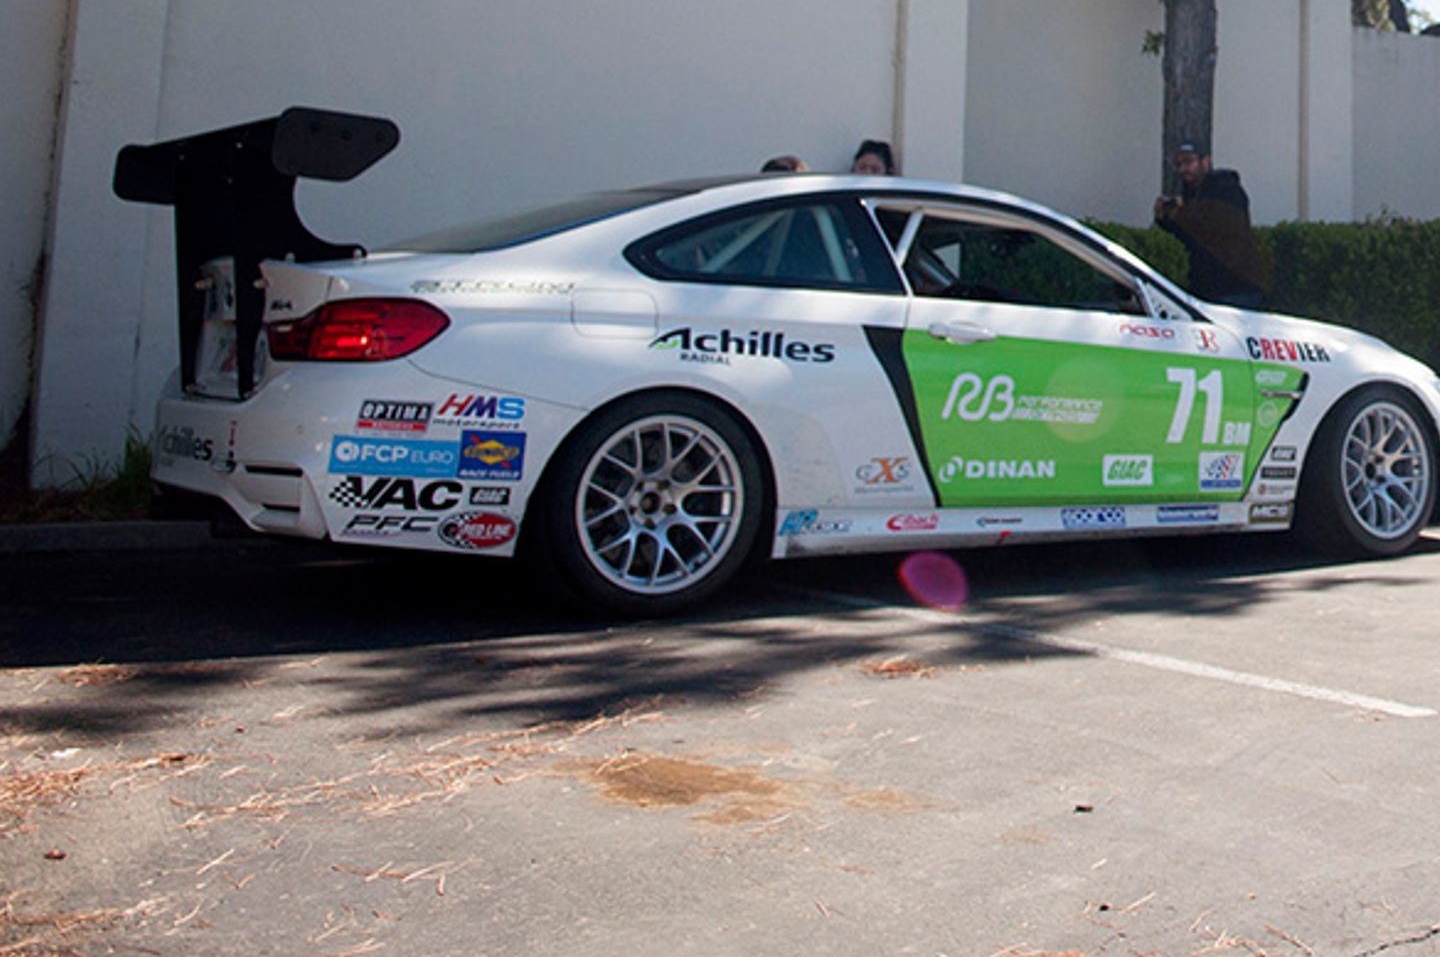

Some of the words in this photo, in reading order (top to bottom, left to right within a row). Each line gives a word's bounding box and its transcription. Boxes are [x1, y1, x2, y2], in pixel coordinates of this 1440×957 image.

[648, 326, 836, 363] Achilles
[1245, 336, 1331, 363] CREVIER
[680, 353, 731, 365] RADIAL
[361, 401, 430, 421] OPTIMA
[438, 393, 526, 420] HMS
[1166, 367, 1223, 444] 71
[1223, 422, 1250, 445] BM
[361, 445, 409, 463] FCP
[411, 450, 453, 465] EURO
[965, 459, 1055, 479] DINAN
[346, 475, 464, 511] VAC
[346, 514, 440, 532] PFC
